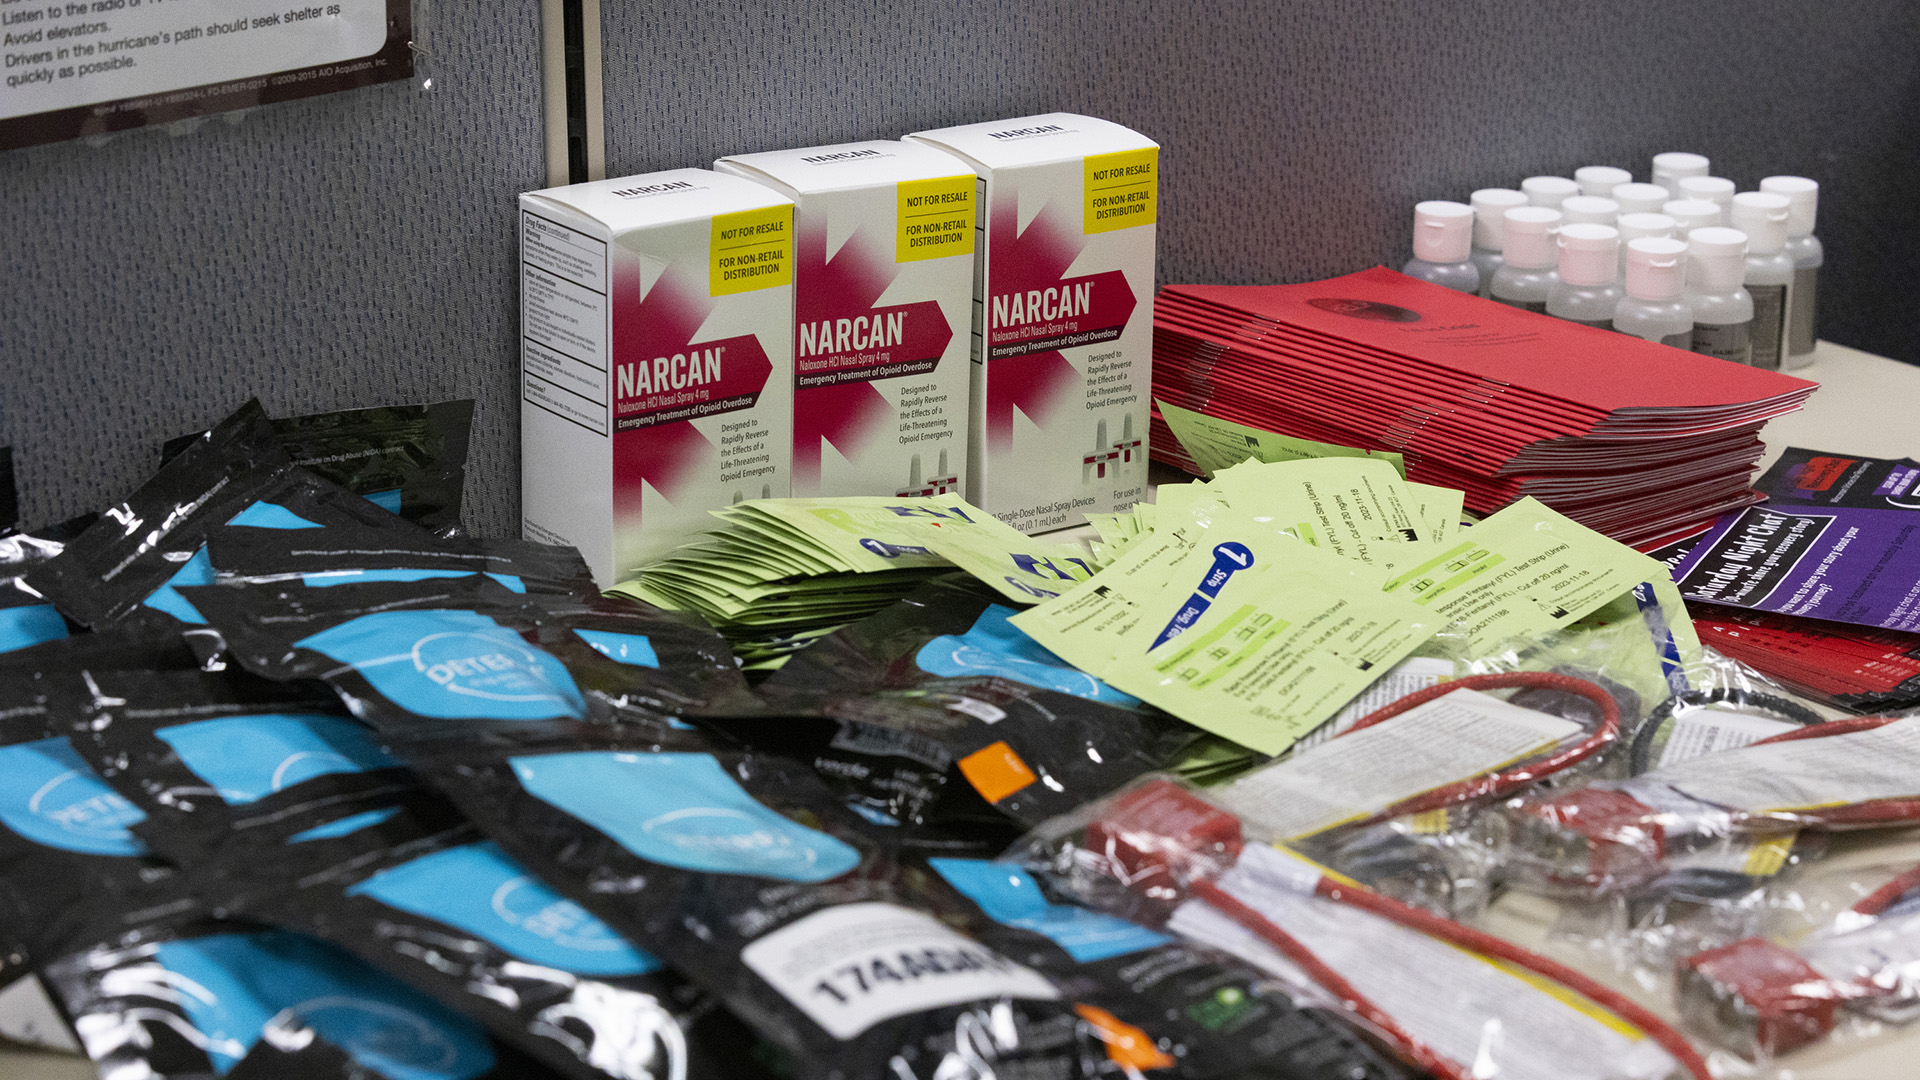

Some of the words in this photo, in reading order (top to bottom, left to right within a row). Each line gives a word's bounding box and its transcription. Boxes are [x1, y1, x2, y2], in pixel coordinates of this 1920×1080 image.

[2, 9, 43, 25] Listen
[66, 3, 88, 17] the
[91, 0, 125, 12] radio
[3, 29, 43, 47] Avoid
[47, 20, 112, 39] elevators.
[5, 51, 53, 68] Drivers
[73, 43, 95, 57] the
[98, 31, 171, 53] hurricane's
[174, 25, 201, 45] path
[206, 18, 248, 38] should
[251, 12, 281, 32] seek
[283, 6, 325, 27] shelter
[6, 68, 54, 88] quickly
[78, 56, 137, 78] possible.
[988, 124, 1064, 140] NARCAN
[801, 150, 880, 163] NARCAN
[1094, 170, 1108, 181] NOT
[1110, 167, 1125, 178] FOR
[1126, 163, 1150, 176] RESALE
[612, 181, 693, 197] NARCAN
[907, 197, 922, 207] NOT
[924, 195, 940, 205] FOR
[941, 192, 968, 203] RESALE
[1093, 198, 1107, 208] FOR
[1109, 190, 1150, 206] NON-RETAIL
[1096, 203, 1146, 220] DISTRIBUTION
[721, 229, 737, 240] NOT
[739, 226, 755, 238] FOR
[756, 221, 784, 235] RESALE
[906, 225, 922, 235] FOR
[923, 219, 967, 233] NON-RETAIL
[910, 232, 963, 247] DISTRIBUTION
[719, 256, 736, 268] FOR
[737, 250, 784, 266] NON-RETAIL
[723, 263, 779, 281] DISTRIBUTION
[993, 330, 1019, 342] Naloxone
[1030, 325, 1047, 336] Nasal
[1048, 322, 1064, 335] Spray
[993, 343, 1027, 357] Emergency
[1028, 338, 1060, 351] Treatment
[1068, 332, 1089, 346] Opioid
[1089, 329, 1118, 341] Overdose
[800, 359, 827, 371] Naloxone
[840, 356, 857, 366] Nasal
[858, 352, 875, 365] Spray
[1088, 351, 1116, 364] Designed
[800, 372, 837, 385] Emergency
[838, 368, 871, 380] Treatment
[880, 363, 901, 376] Opioid
[902, 361, 933, 372] Overdose
[1088, 363, 1109, 375] Rapidly
[1110, 360, 1132, 371] Reverse
[1087, 378, 1097, 386] the
[1097, 375, 1115, 385] Effects
[901, 384, 930, 396] Designed
[1086, 383, 1132, 398] Life-Threatening
[618, 400, 647, 413] Naloxone
[659, 393, 676, 406] Nasal
[677, 391, 694, 405] Spray
[901, 396, 924, 407] Rapidly
[924, 393, 948, 404] Reverse
[1086, 398, 1106, 411] Opioid
[1106, 394, 1137, 407] Emergency
[618, 415, 655, 429] Emergency
[656, 409, 690, 421] Treatment
[699, 402, 721, 415] Opioid
[722, 396, 753, 409] Overdose
[900, 412, 910, 420] the
[911, 408, 931, 418] Effects
[721, 420, 750, 433] Designed
[900, 418, 948, 432] Life-Threatening
[721, 431, 744, 445] Rapidly
[745, 429, 769, 440] Reverse
[899, 432, 920, 445] Opioid
[921, 429, 953, 441] Emergency
[331, 454, 345, 463] Drug
[345, 451, 362, 460] Abuse
[721, 448, 731, 457] the
[732, 445, 752, 455] Effects
[721, 453, 770, 470] Life-Threatening
[720, 469, 742, 482] Opioid
[743, 465, 776, 478] Emergency
[1113, 489, 1123, 499] For
[1124, 489, 1134, 498] use
[1302, 481, 1319, 501] (Urine)
[997, 506, 1035, 524] Single-Dose
[1036, 503, 1053, 516] Nasal
[1054, 498, 1071, 513] Spray
[1072, 496, 1095, 509] Devices
[1113, 503, 1127, 512] nose
[1313, 501, 1325, 516] Strip
[1333, 494, 1347, 511] ng/ml
[1350, 488, 1372, 521] 2023-11-18
[1039, 516, 1051, 527] mL)
[1052, 514, 1066, 525] each
[1321, 515, 1332, 529] Test
[1325, 527, 1341, 546] (FYL)
[1351, 527, 1361, 539] Cut
[1721, 534, 1768, 561] Night
[1746, 513, 1787, 535] Chat
[1843, 526, 1859, 539] your
[1357, 543, 1373, 562] (FYL)
[1747, 566, 1772, 580] share
[1763, 553, 1780, 567] your
[1774, 532, 1804, 554] recovery
[1789, 517, 1815, 533] story)
[1832, 538, 1851, 552] about
[1218, 546, 1248, 566] 1
[1823, 551, 1842, 564] story
[1207, 569, 1227, 587] Strip
[1466, 579, 1496, 597] Fentanyl
[1495, 569, 1517, 584] (FYL)
[1513, 562, 1530, 573] Test
[1528, 553, 1546, 566] Strip
[1545, 542, 1570, 557] (Urine)
[1813, 563, 1829, 576] your
[1494, 590, 1516, 603] (FYL)
[1517, 583, 1532, 593] Cut
[1530, 577, 1541, 586] off
[1550, 563, 1570, 577] ng/ml
[1551, 570, 1590, 591] 2023-11-18
[1801, 575, 1820, 588] share
[1463, 599, 1478, 609] Use
[1478, 590, 1494, 601] only
